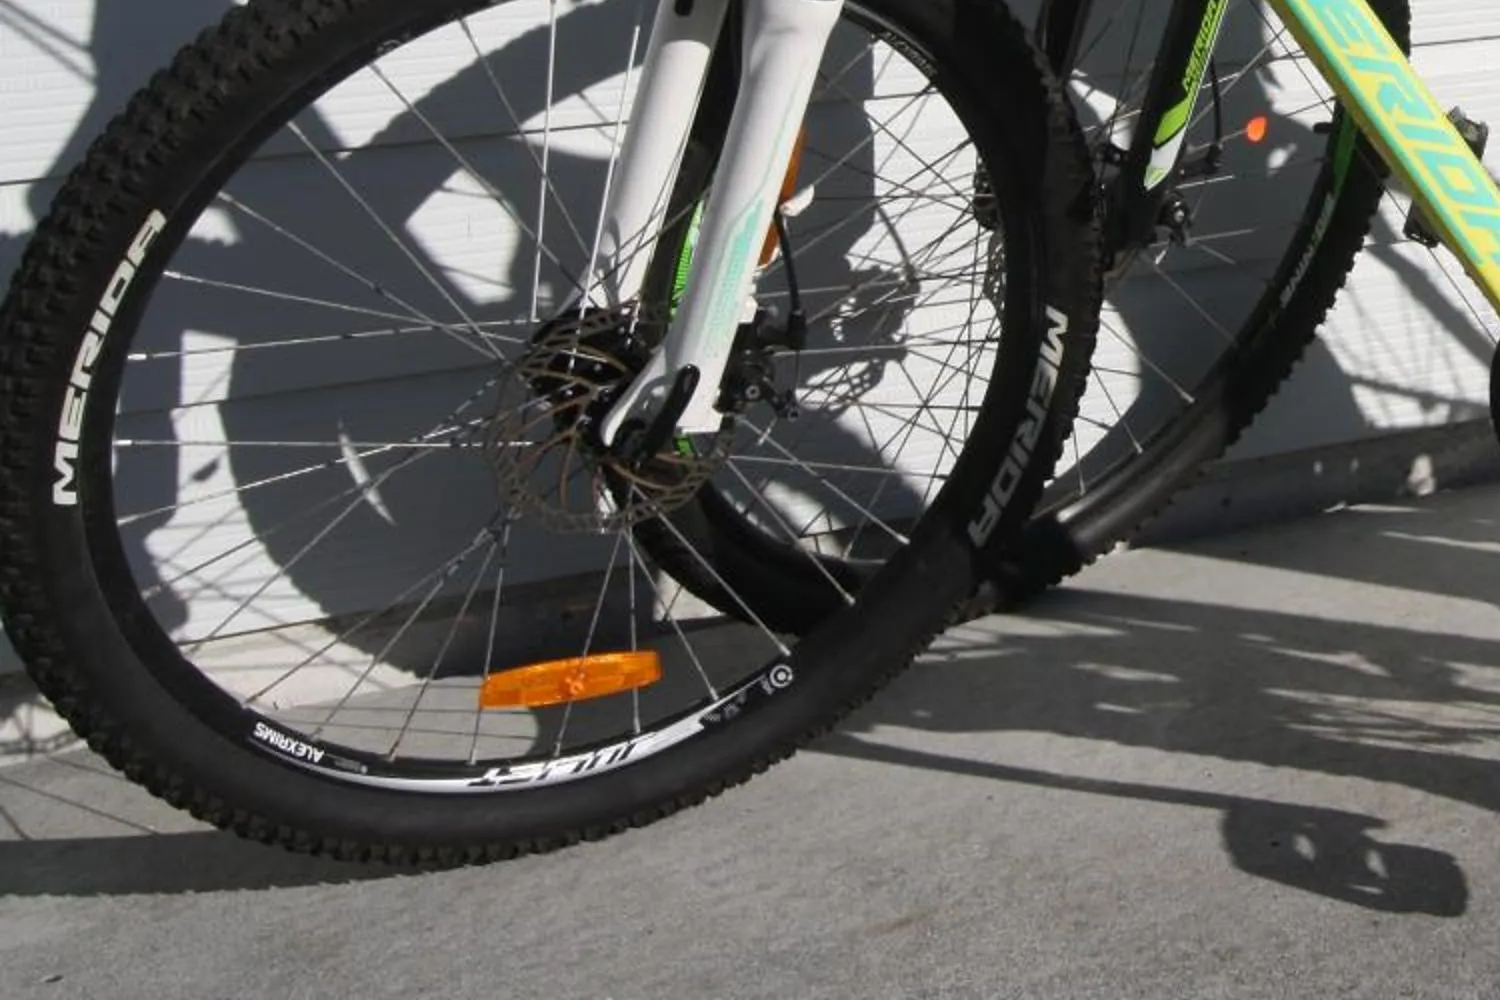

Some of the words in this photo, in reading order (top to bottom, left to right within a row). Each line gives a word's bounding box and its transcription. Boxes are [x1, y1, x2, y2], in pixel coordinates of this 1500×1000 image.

[53, 209, 166, 505] MERIDA
[967, 306, 1068, 549] MERIDA
[253, 721, 324, 763] ALEXRIMS
